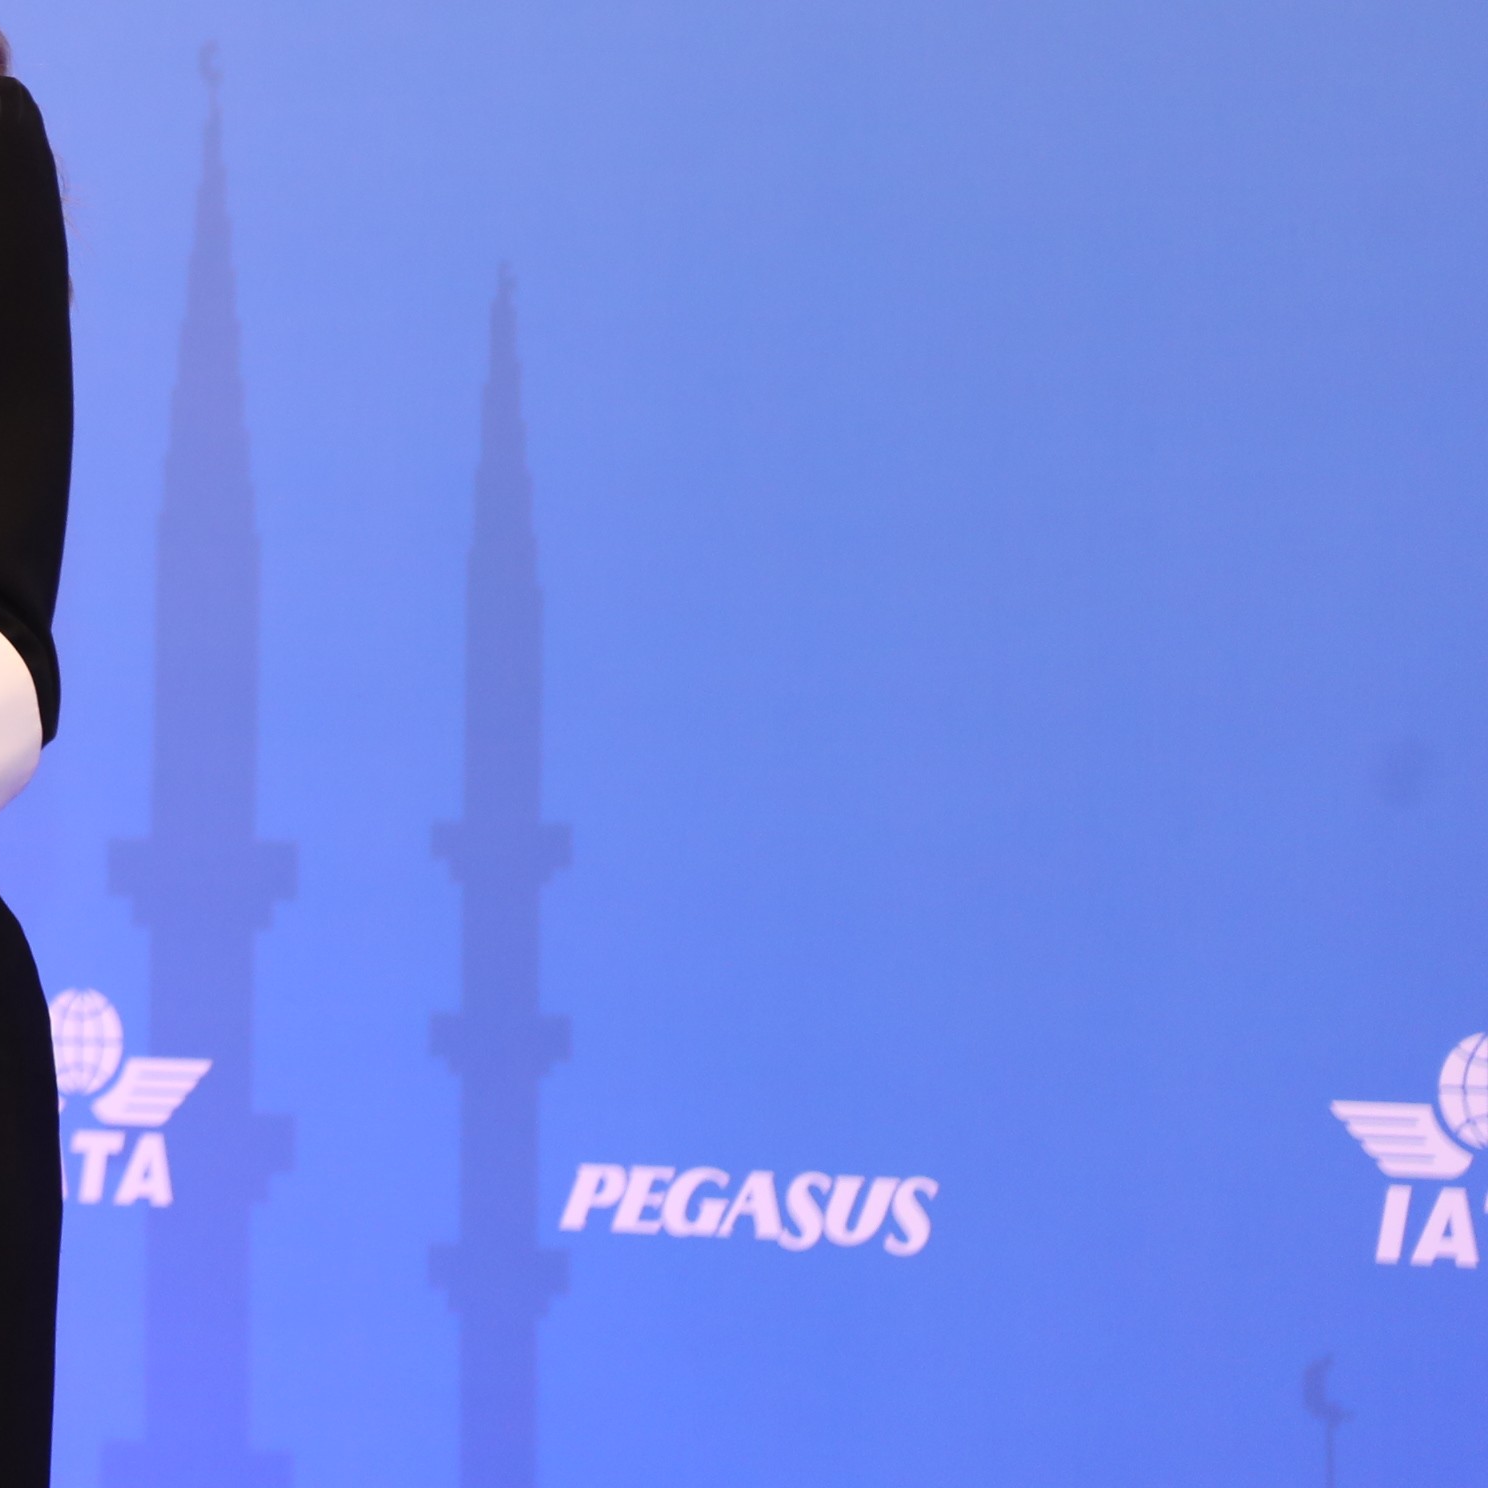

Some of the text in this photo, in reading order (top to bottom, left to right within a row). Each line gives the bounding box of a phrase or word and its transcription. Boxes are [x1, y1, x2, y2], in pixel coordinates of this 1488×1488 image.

[60, 1129, 174, 1209] TA
[559, 1162, 939, 1256] PEGASUS
[1375, 1183, 1488, 1269] IA
